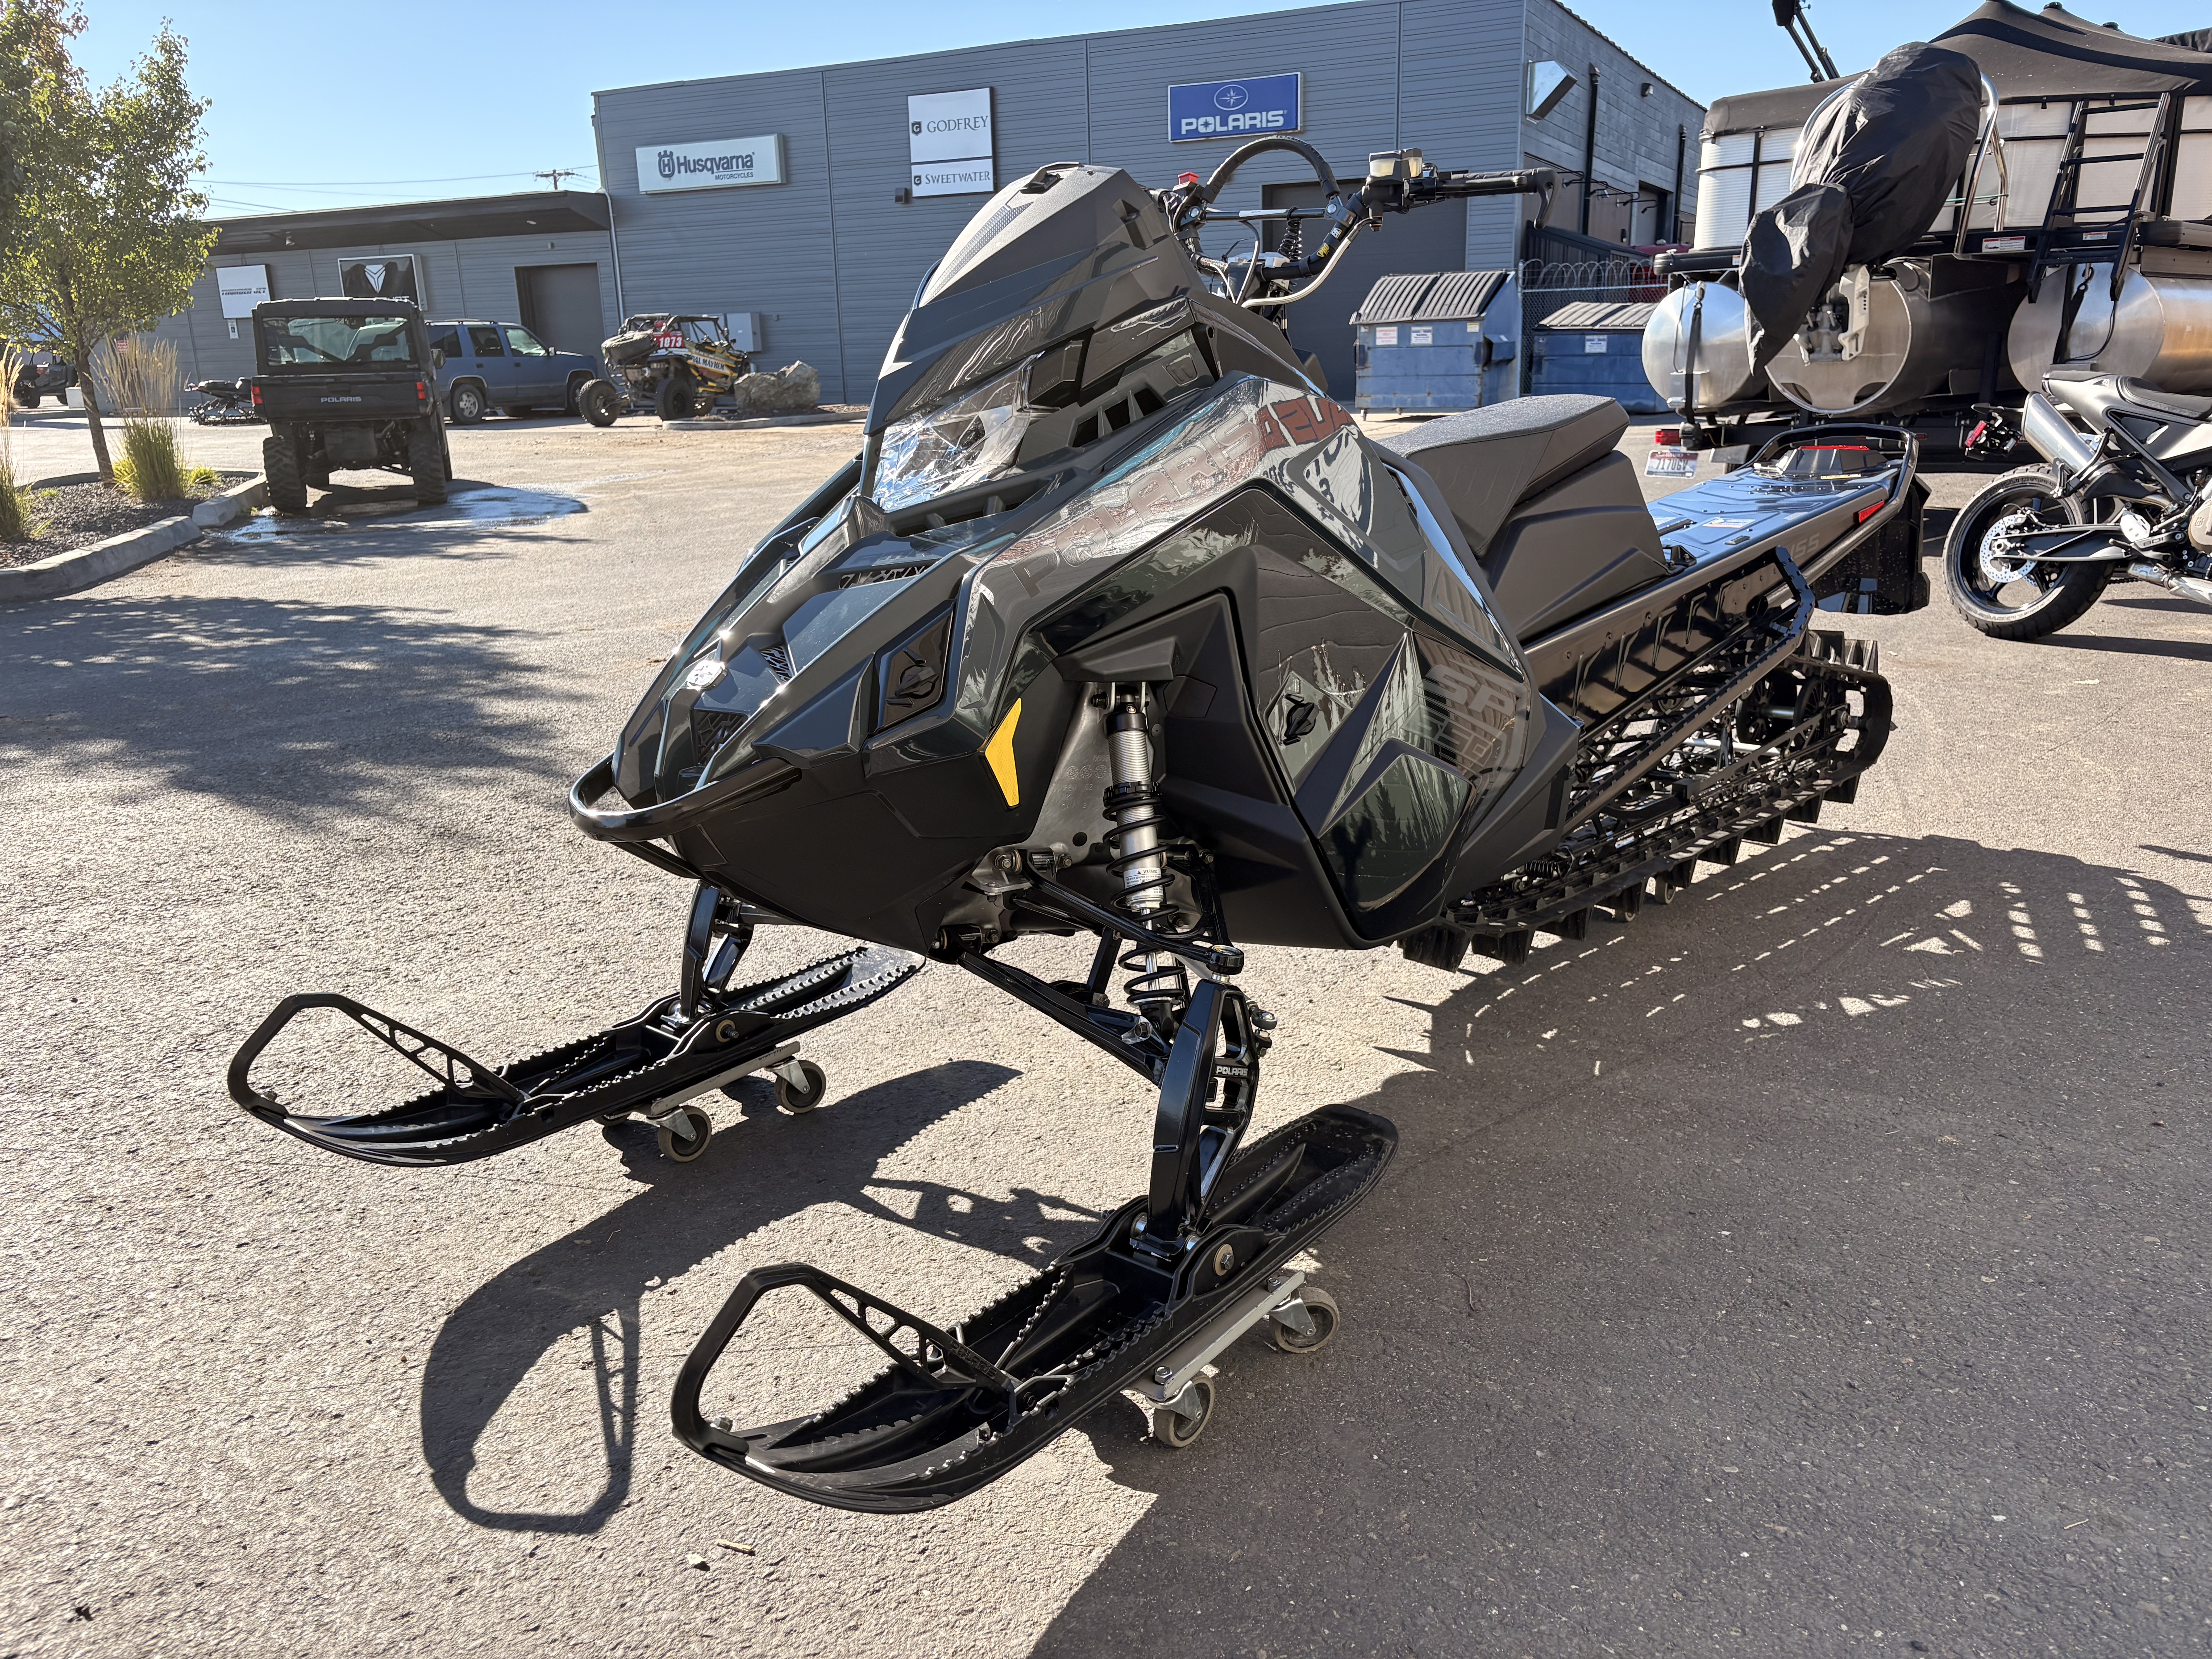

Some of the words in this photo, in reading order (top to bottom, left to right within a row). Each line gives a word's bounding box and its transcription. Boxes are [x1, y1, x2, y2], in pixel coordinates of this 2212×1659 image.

[927, 116, 988, 133] GODFREY
[1181, 110, 1284, 135] POLARIS
[676, 153, 754, 174] Husqvarna
[715, 172, 754, 180] MOTORCYCLES
[925, 171, 991, 184] SWEETWATER
[702, 359, 726, 371] MAYHEM
[1030, 375, 1059, 397] POLARIS
[1010, 410, 1261, 598] POLARIS
[1417, 663, 1515, 717] SP
[1216, 1066, 1248, 1076] POLARIS
[950, 1340, 998, 1380] POLARIS
